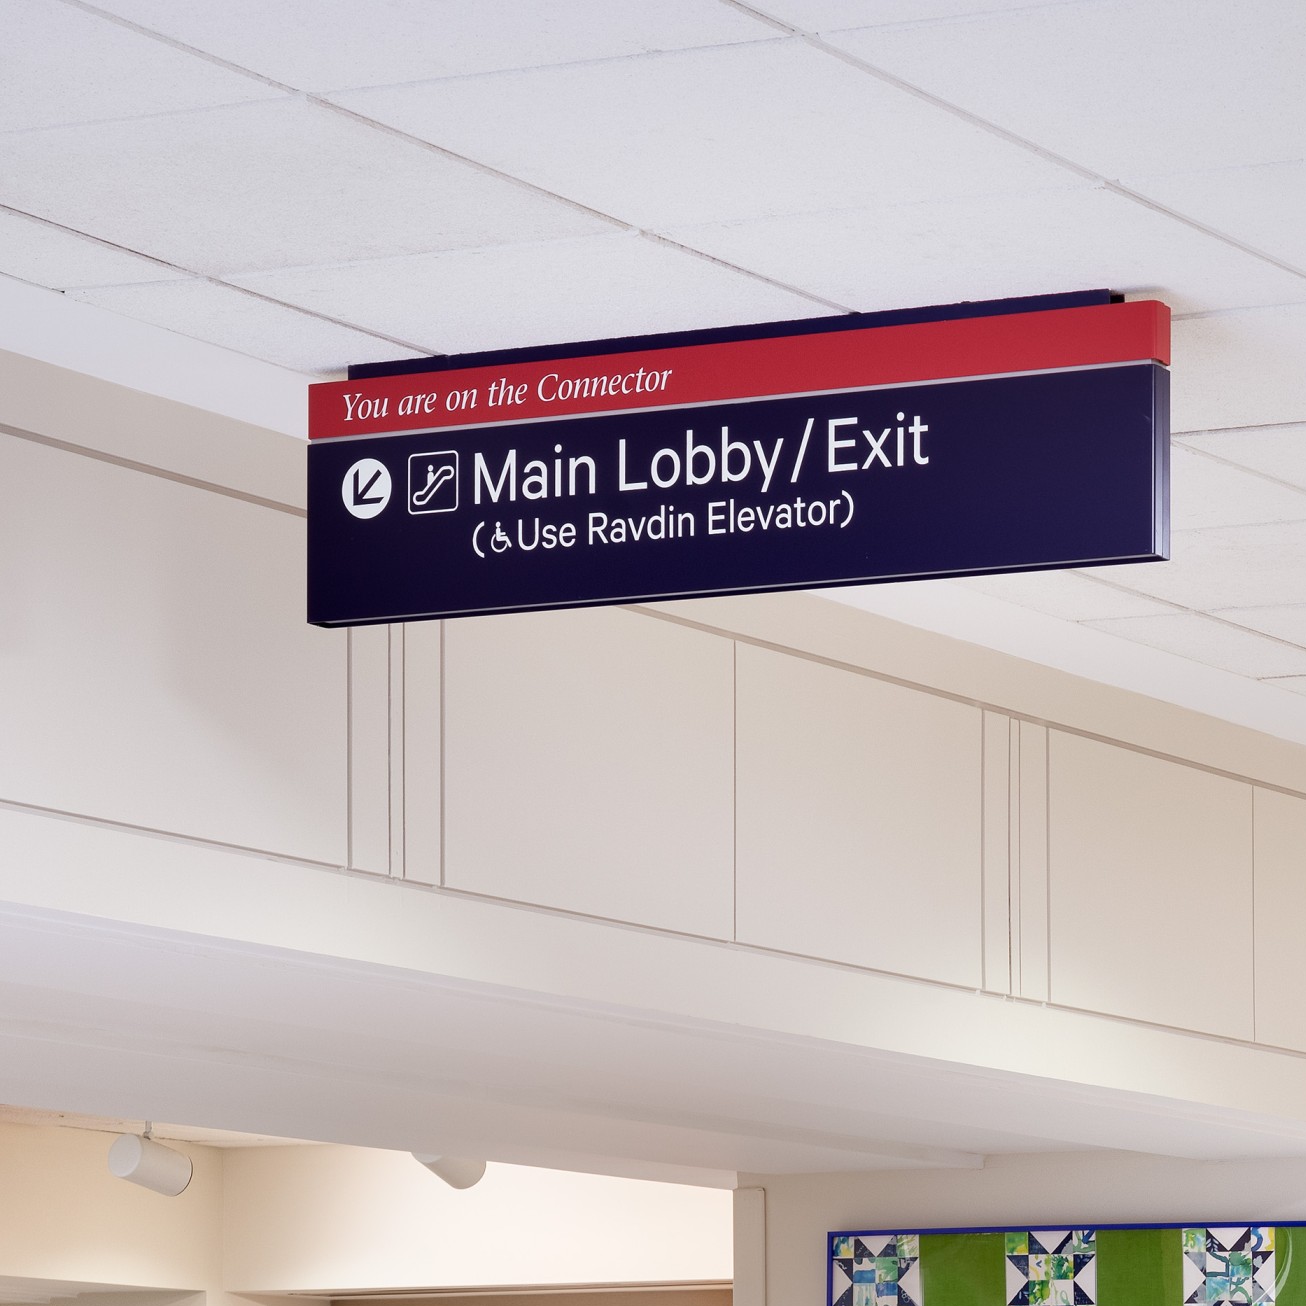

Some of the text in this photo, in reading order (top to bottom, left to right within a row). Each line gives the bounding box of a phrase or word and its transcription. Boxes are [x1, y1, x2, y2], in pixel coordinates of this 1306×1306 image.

[342, 367, 673, 421] You are on the Connector
[474, 443, 596, 505] Main
[588, 504, 695, 546] Ravdin
[708, 489, 855, 535] Elevator)
